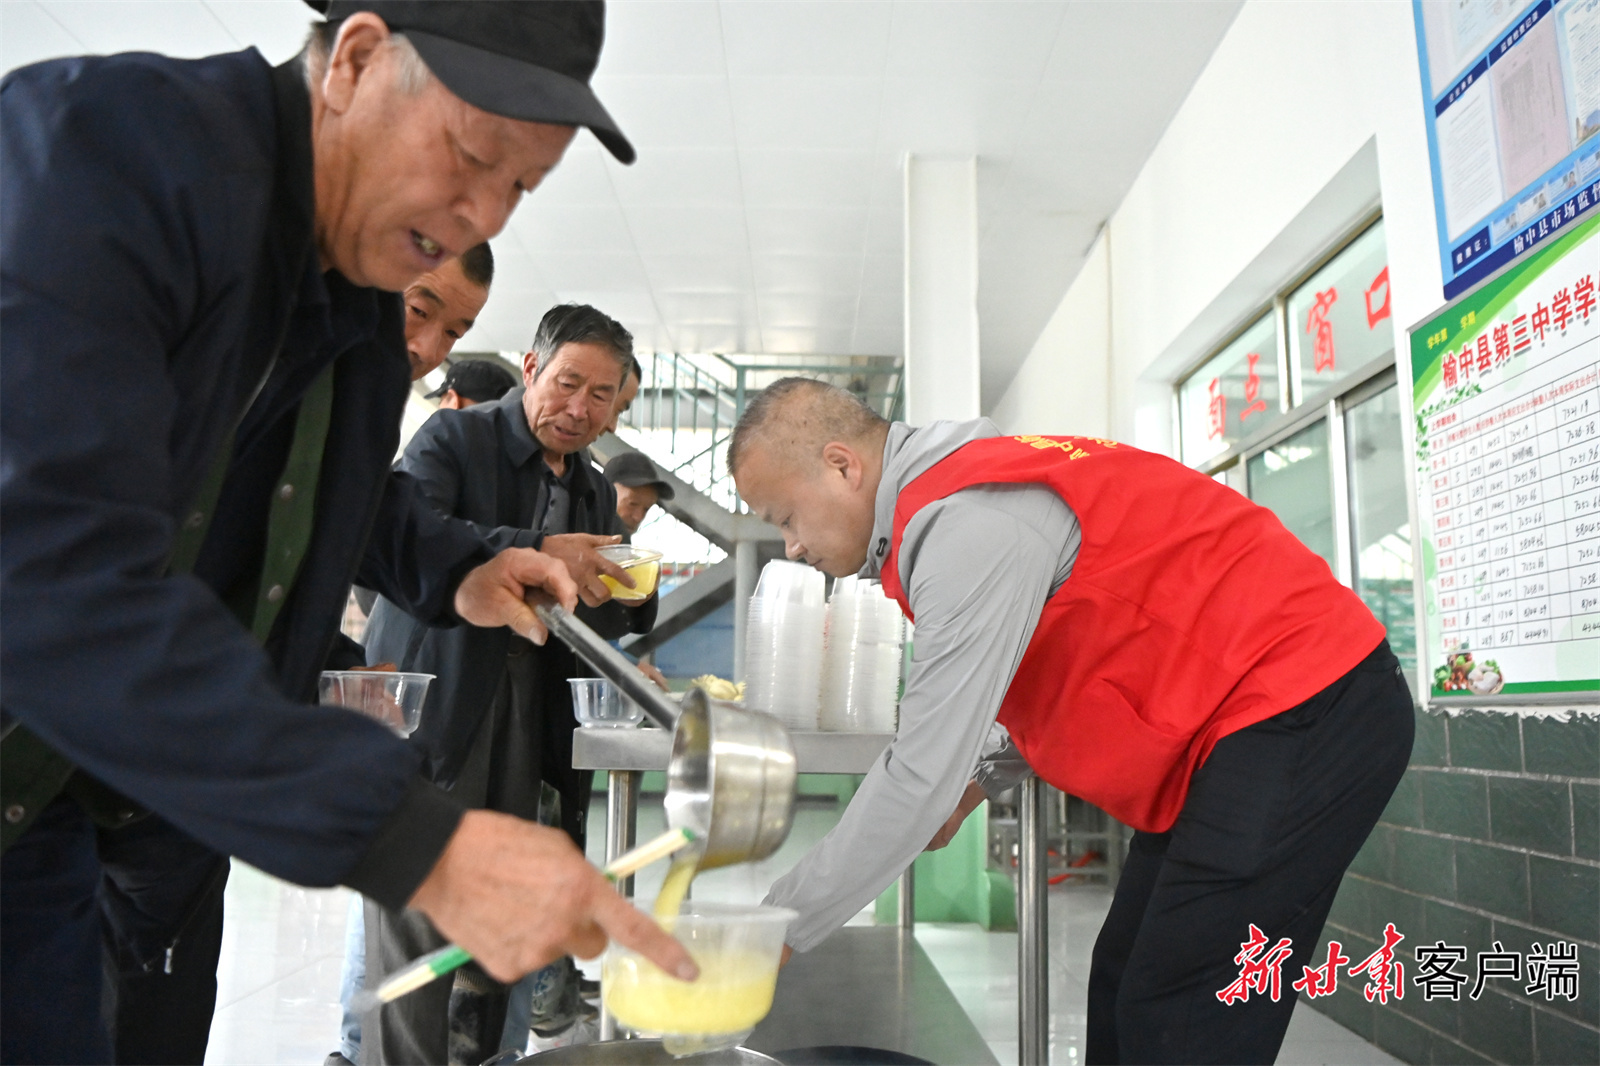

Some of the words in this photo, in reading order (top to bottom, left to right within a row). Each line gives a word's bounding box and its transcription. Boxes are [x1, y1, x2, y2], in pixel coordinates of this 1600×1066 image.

[1442, 271, 1600, 389] 榆中县第三中学学
[1460, 311, 1476, 330] 学期
